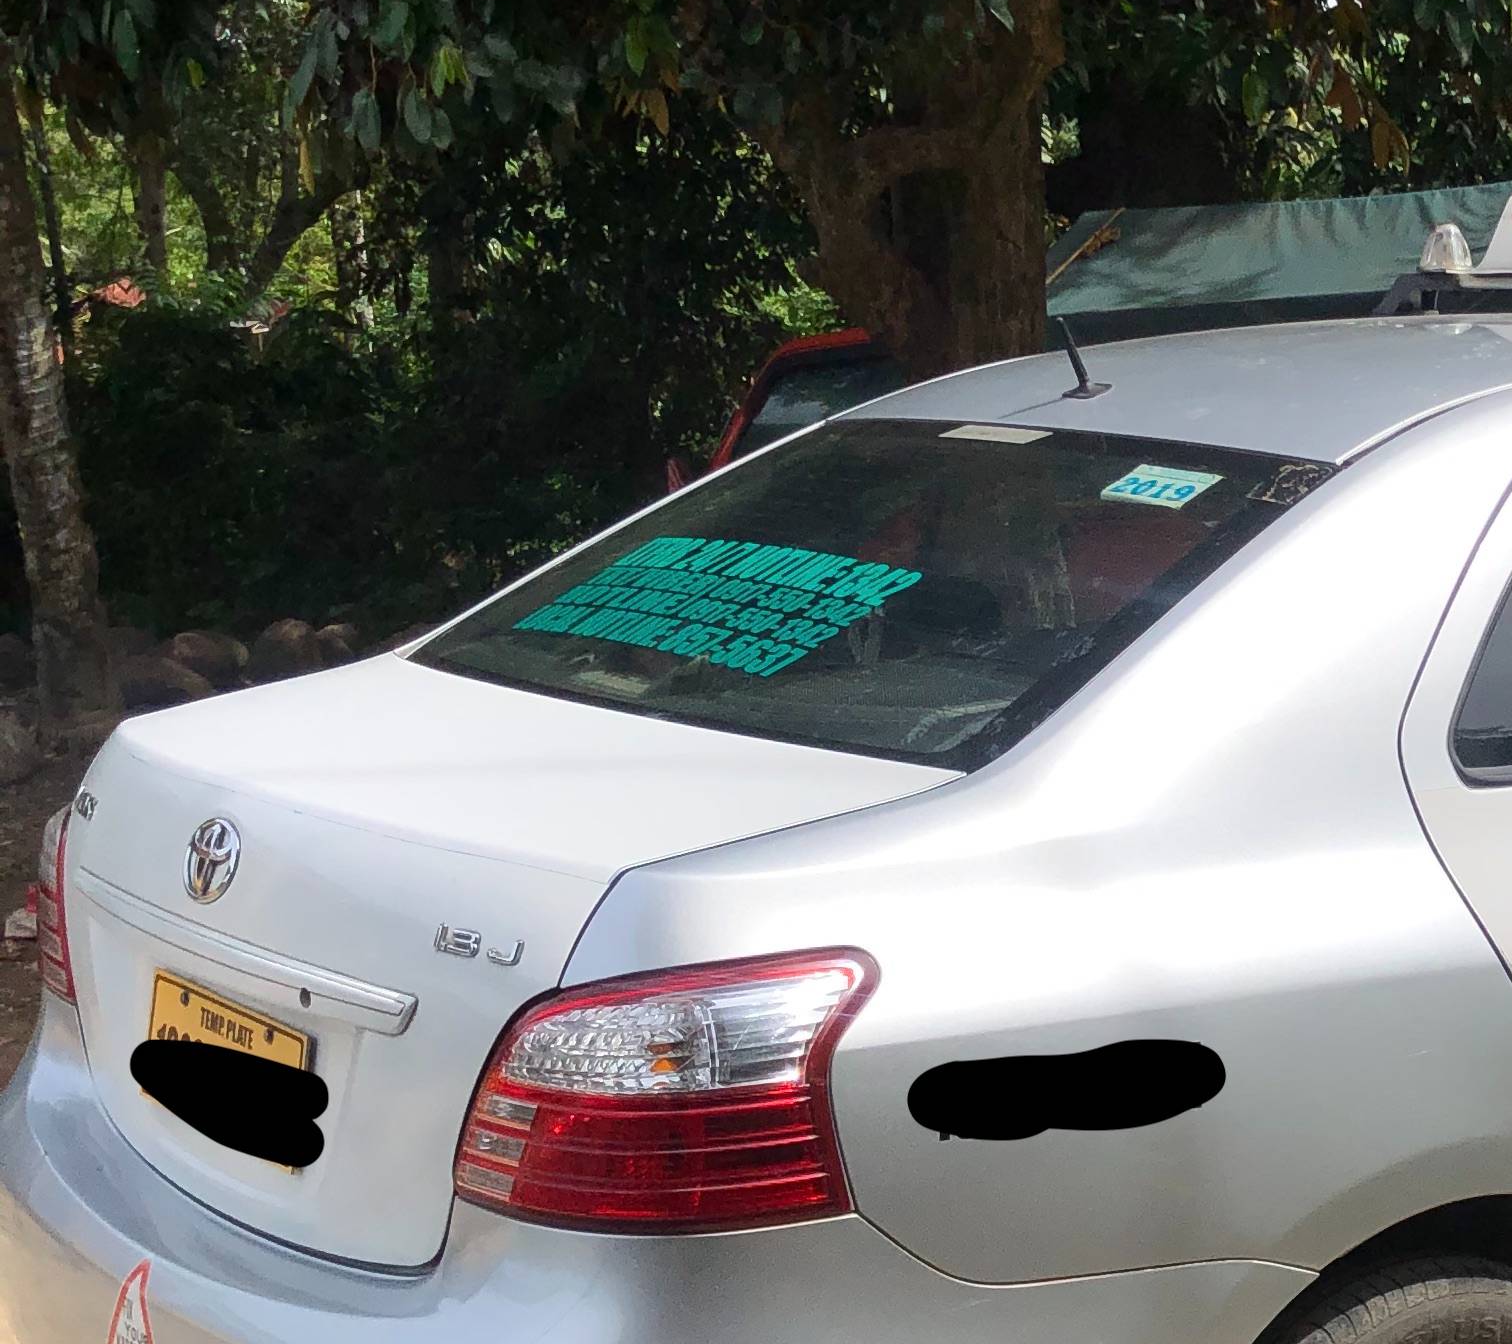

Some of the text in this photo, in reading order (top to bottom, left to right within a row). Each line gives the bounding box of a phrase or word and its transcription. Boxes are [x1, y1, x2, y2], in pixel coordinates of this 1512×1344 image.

[1109, 477, 1197, 501] 2019
[684, 598, 840, 648] 0917-550-1342
[657, 623, 808, 678] 857-5637
[487, 939, 526, 967] J
[225, 1018, 254, 1051] PLATE
